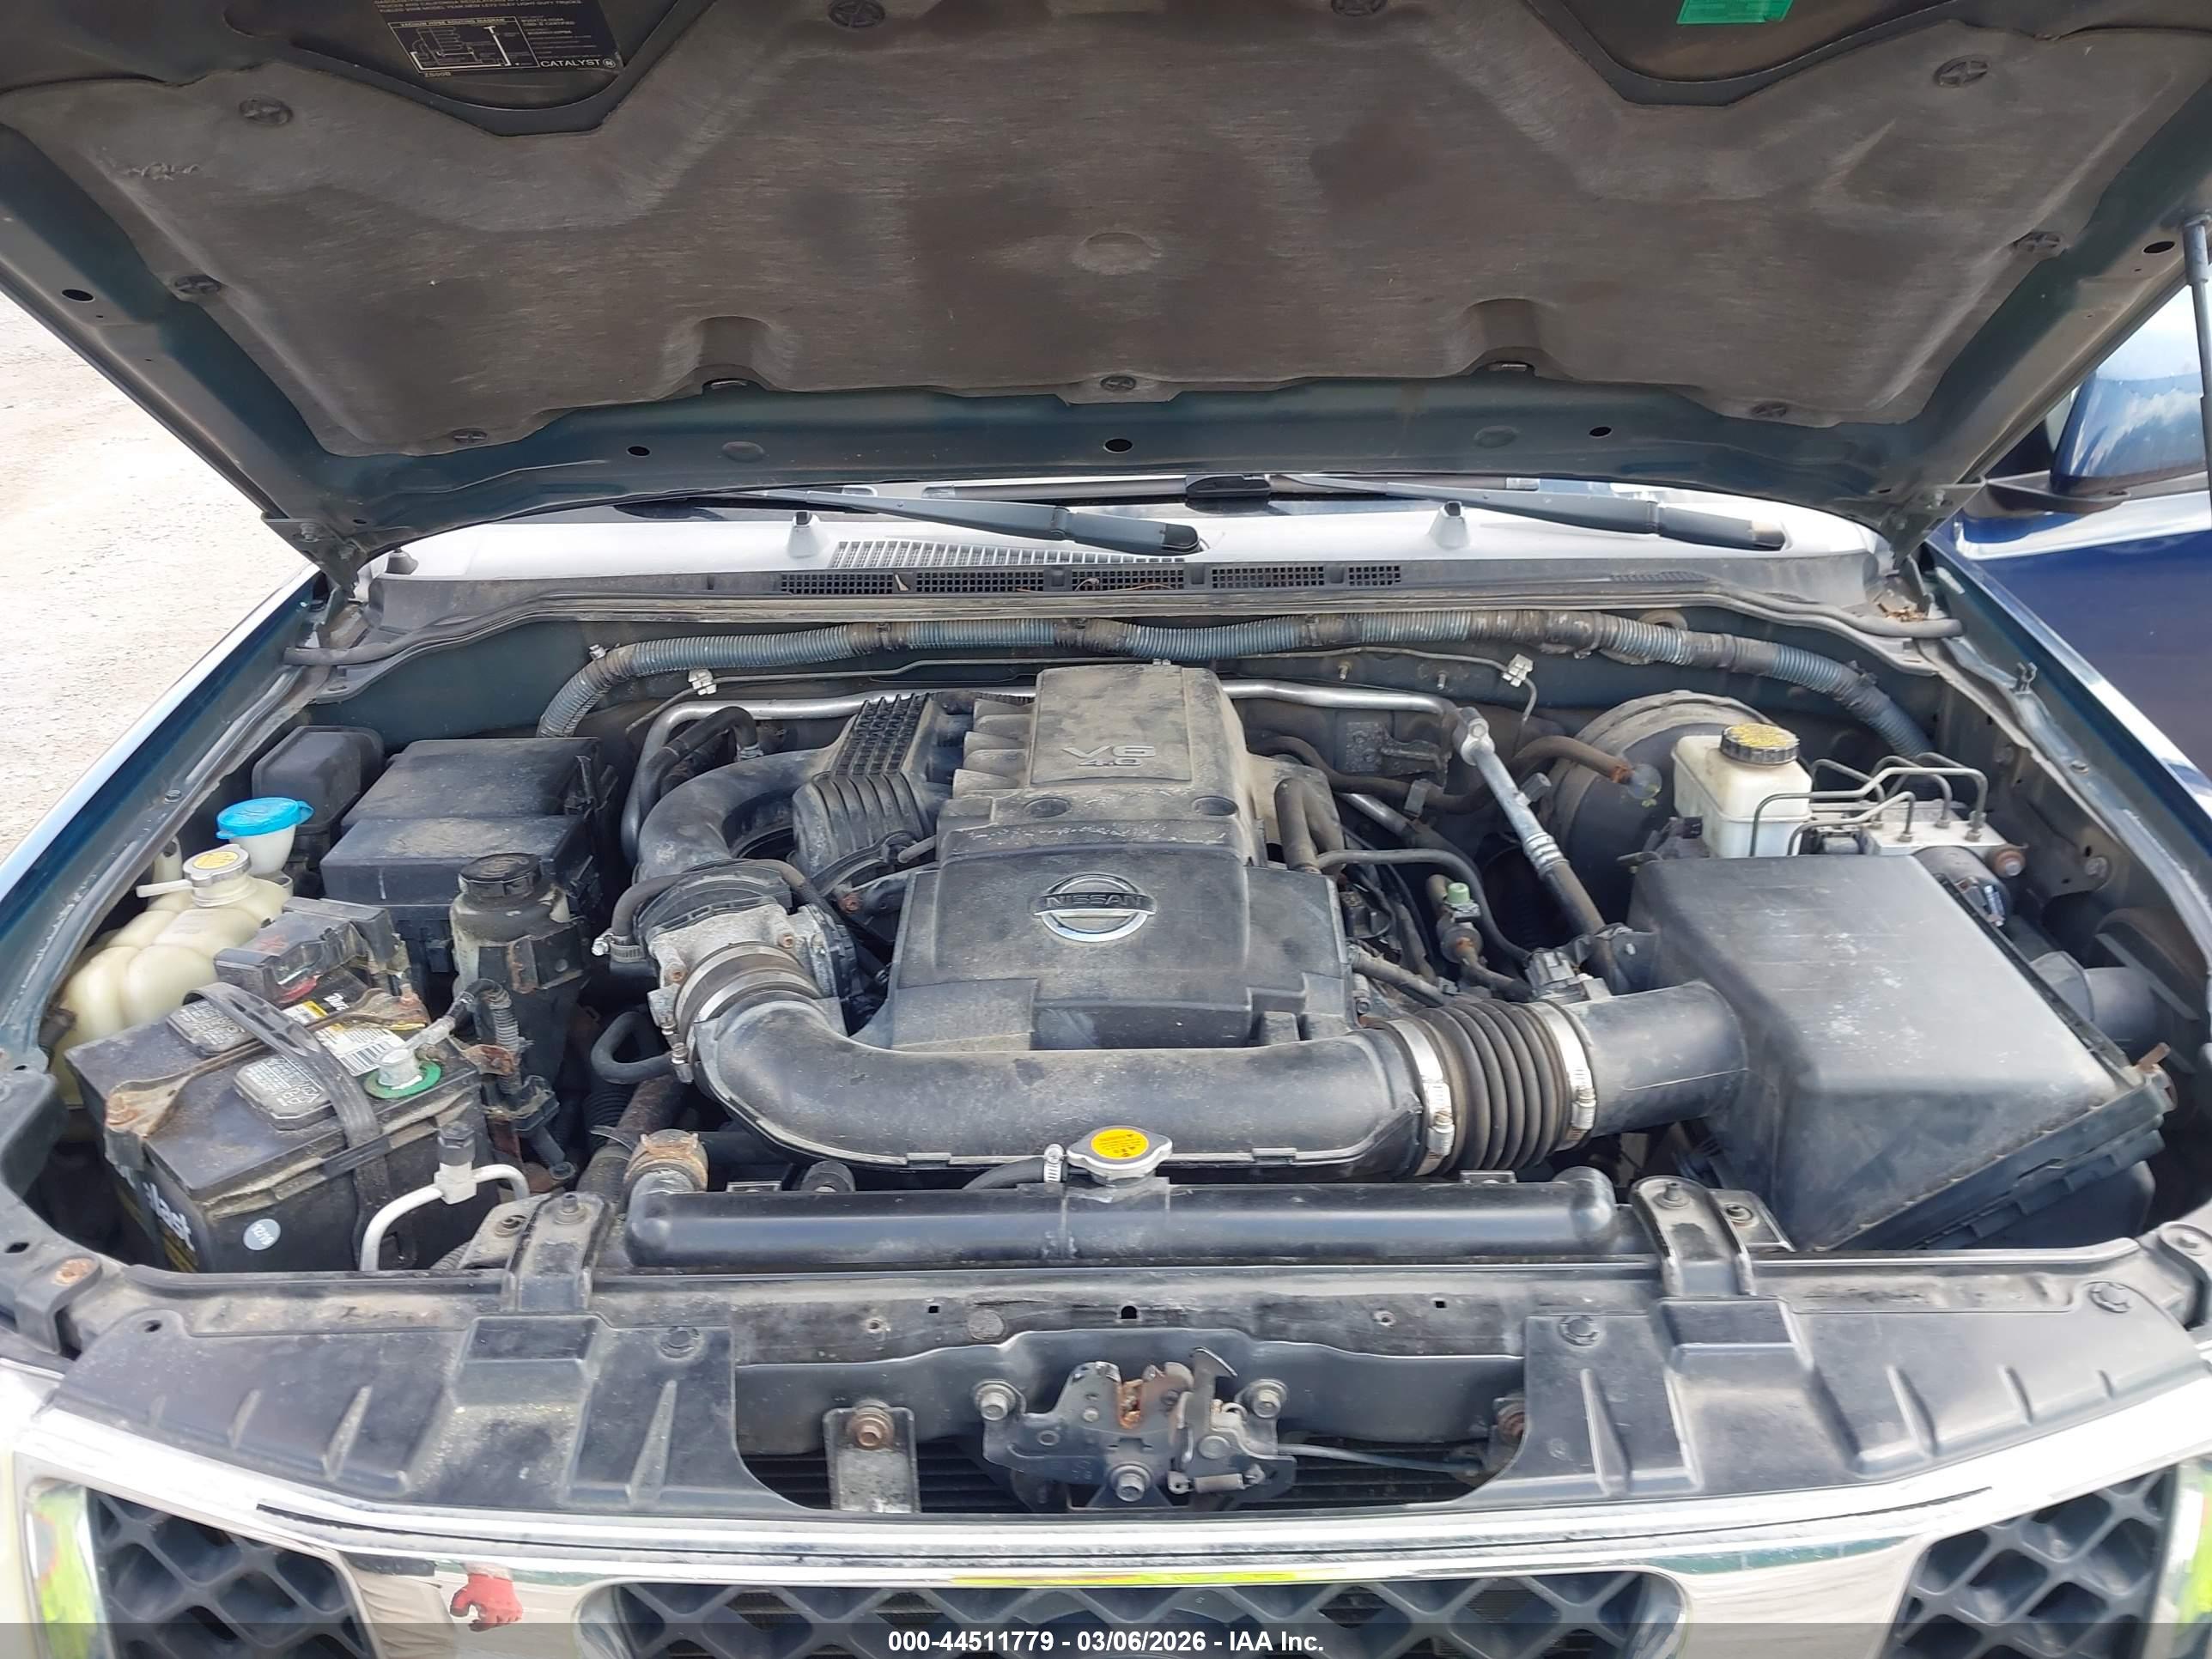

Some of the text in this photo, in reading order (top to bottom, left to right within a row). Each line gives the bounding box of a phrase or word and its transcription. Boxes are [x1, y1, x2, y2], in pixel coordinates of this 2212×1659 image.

[1062, 744, 1156, 757] V6
[1079, 757, 1142, 767] 4.0
[1047, 894, 1143, 908] NISSAN
